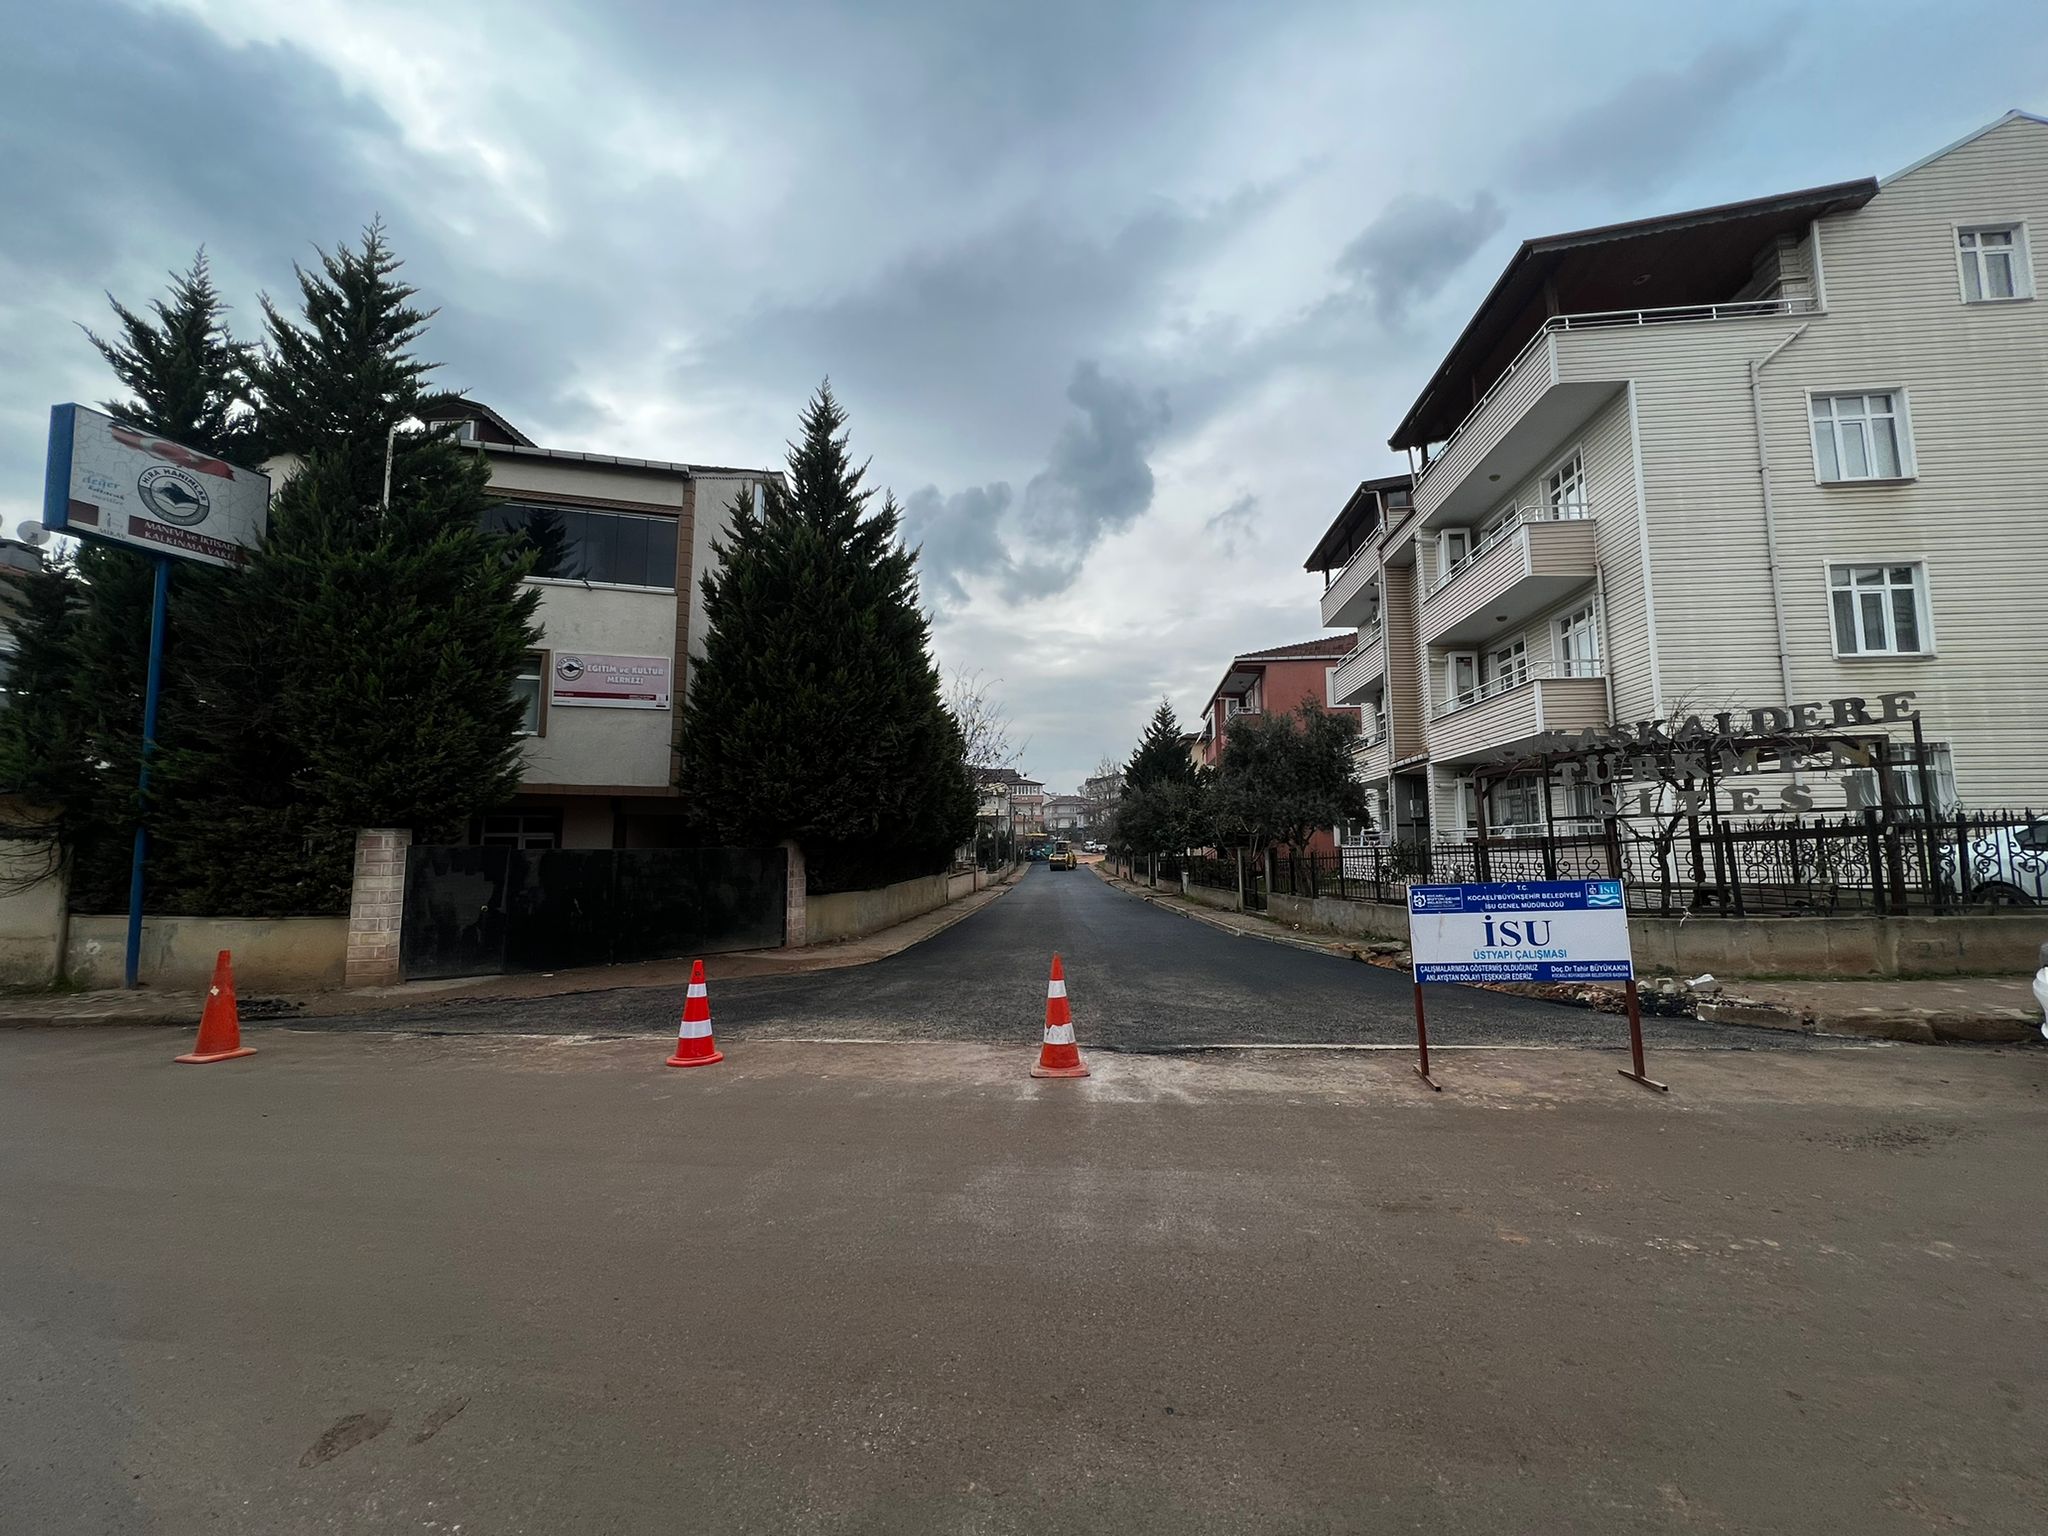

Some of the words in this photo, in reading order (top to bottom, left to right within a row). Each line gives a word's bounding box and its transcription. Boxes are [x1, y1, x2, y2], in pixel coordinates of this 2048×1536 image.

[144, 521, 184, 537] MANEVİ
[186, 532, 198, 541] ve
[144, 531, 203, 552] KALKINMA
[1599, 885, 1619, 894] İSU
[1498, 892, 1541, 901] BÜYÜKŞEHİR
[1542, 891, 1581, 899] BELEDİYESİ
[1521, 901, 1565, 909] MÜDÜRLÜĞÜ
[1482, 915, 1551, 948] İSU
[1473, 949, 1513, 960] ÜSTYAPI
[1515, 949, 1567, 960] ÇALIŞMASI
[1503, 963, 1539, 972] OLDUĞUNUZ
[1590, 963, 1629, 972] BÜYÜKAKIN
